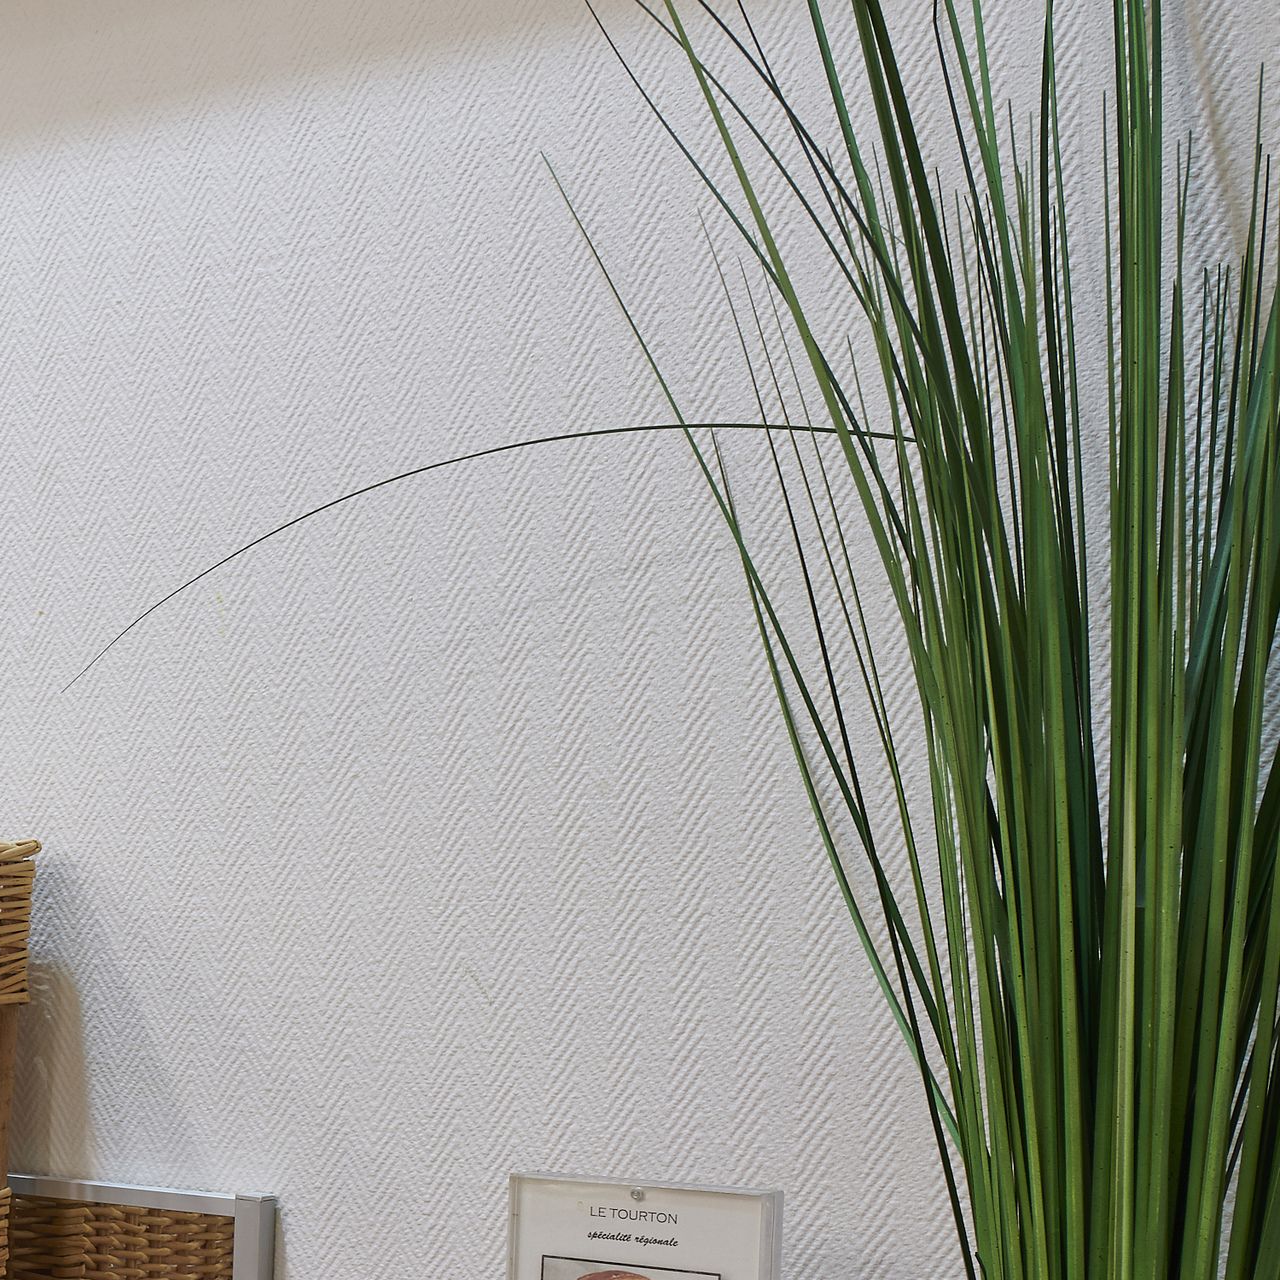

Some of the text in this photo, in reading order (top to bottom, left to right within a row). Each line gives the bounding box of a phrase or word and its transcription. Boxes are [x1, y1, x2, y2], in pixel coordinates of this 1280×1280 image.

[589, 1206, 678, 1225] LE TOURTON
[587, 1231, 679, 1247] spécialité régionale
